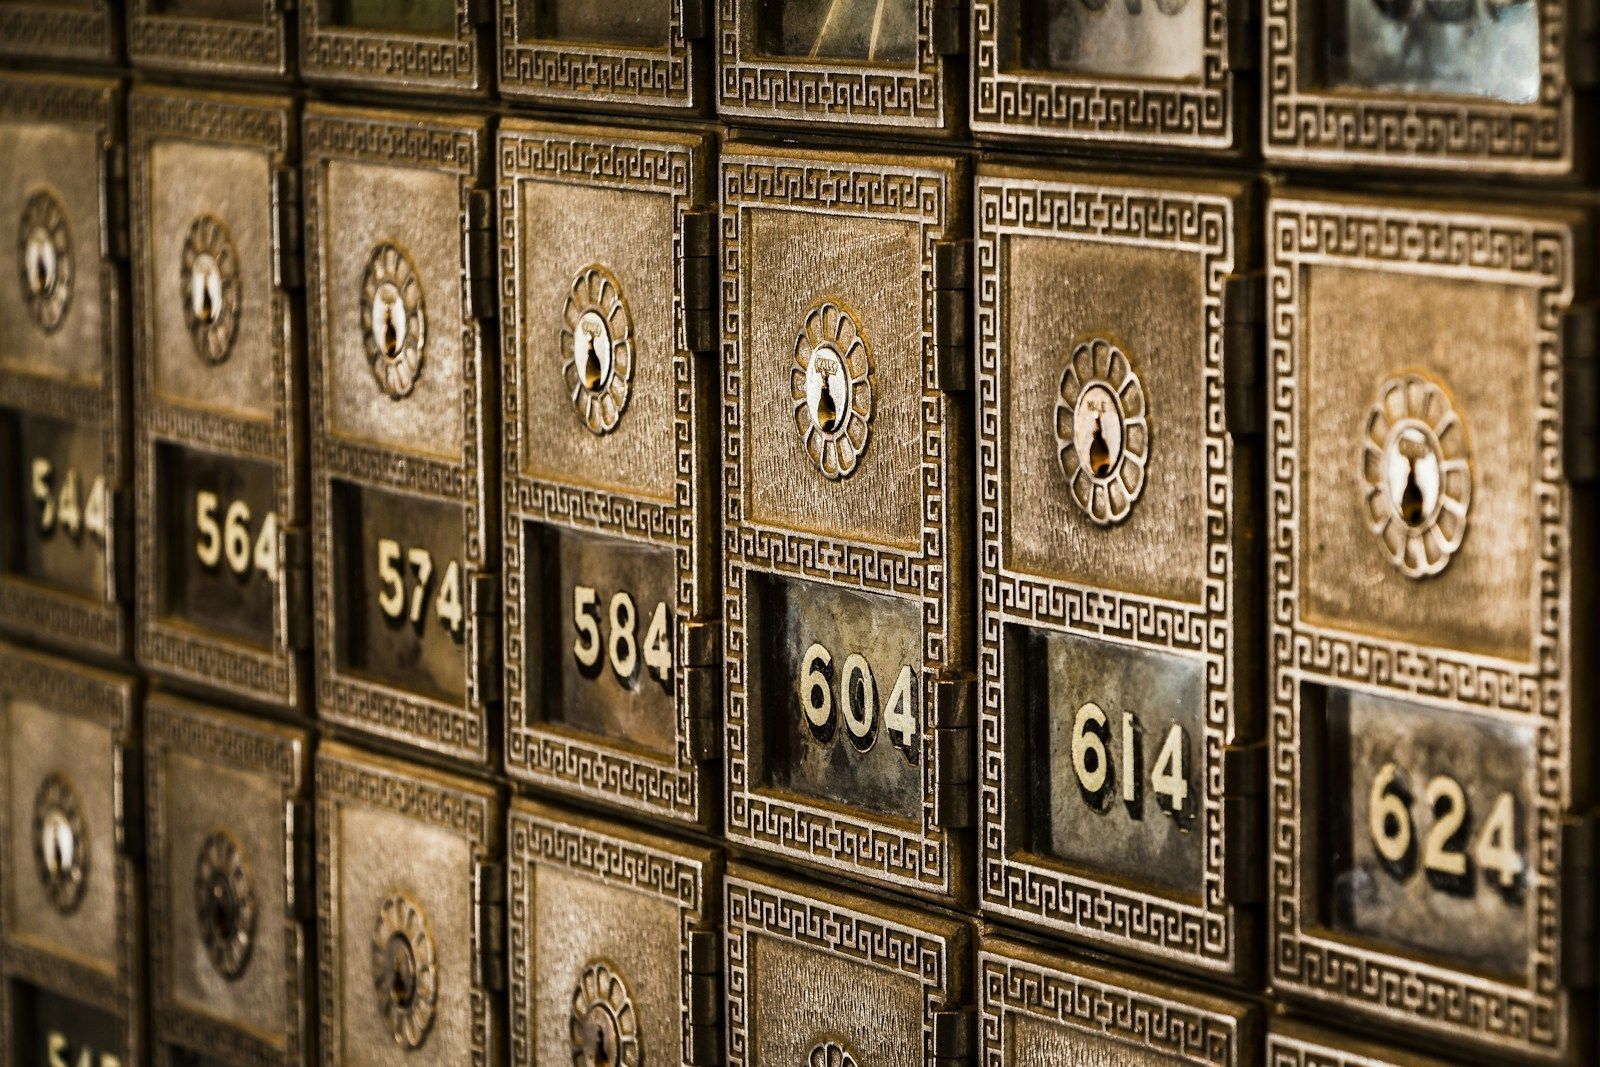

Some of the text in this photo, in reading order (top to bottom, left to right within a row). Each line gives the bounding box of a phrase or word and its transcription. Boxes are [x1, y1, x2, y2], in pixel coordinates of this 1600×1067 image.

[32, 457, 105, 536] 544
[197, 490, 279, 582] 564
[378, 539, 463, 631] 574
[574, 585, 672, 680] 584
[800, 643, 916, 747] 604
[1071, 702, 1188, 811] 614
[1369, 762, 1523, 886] 624
